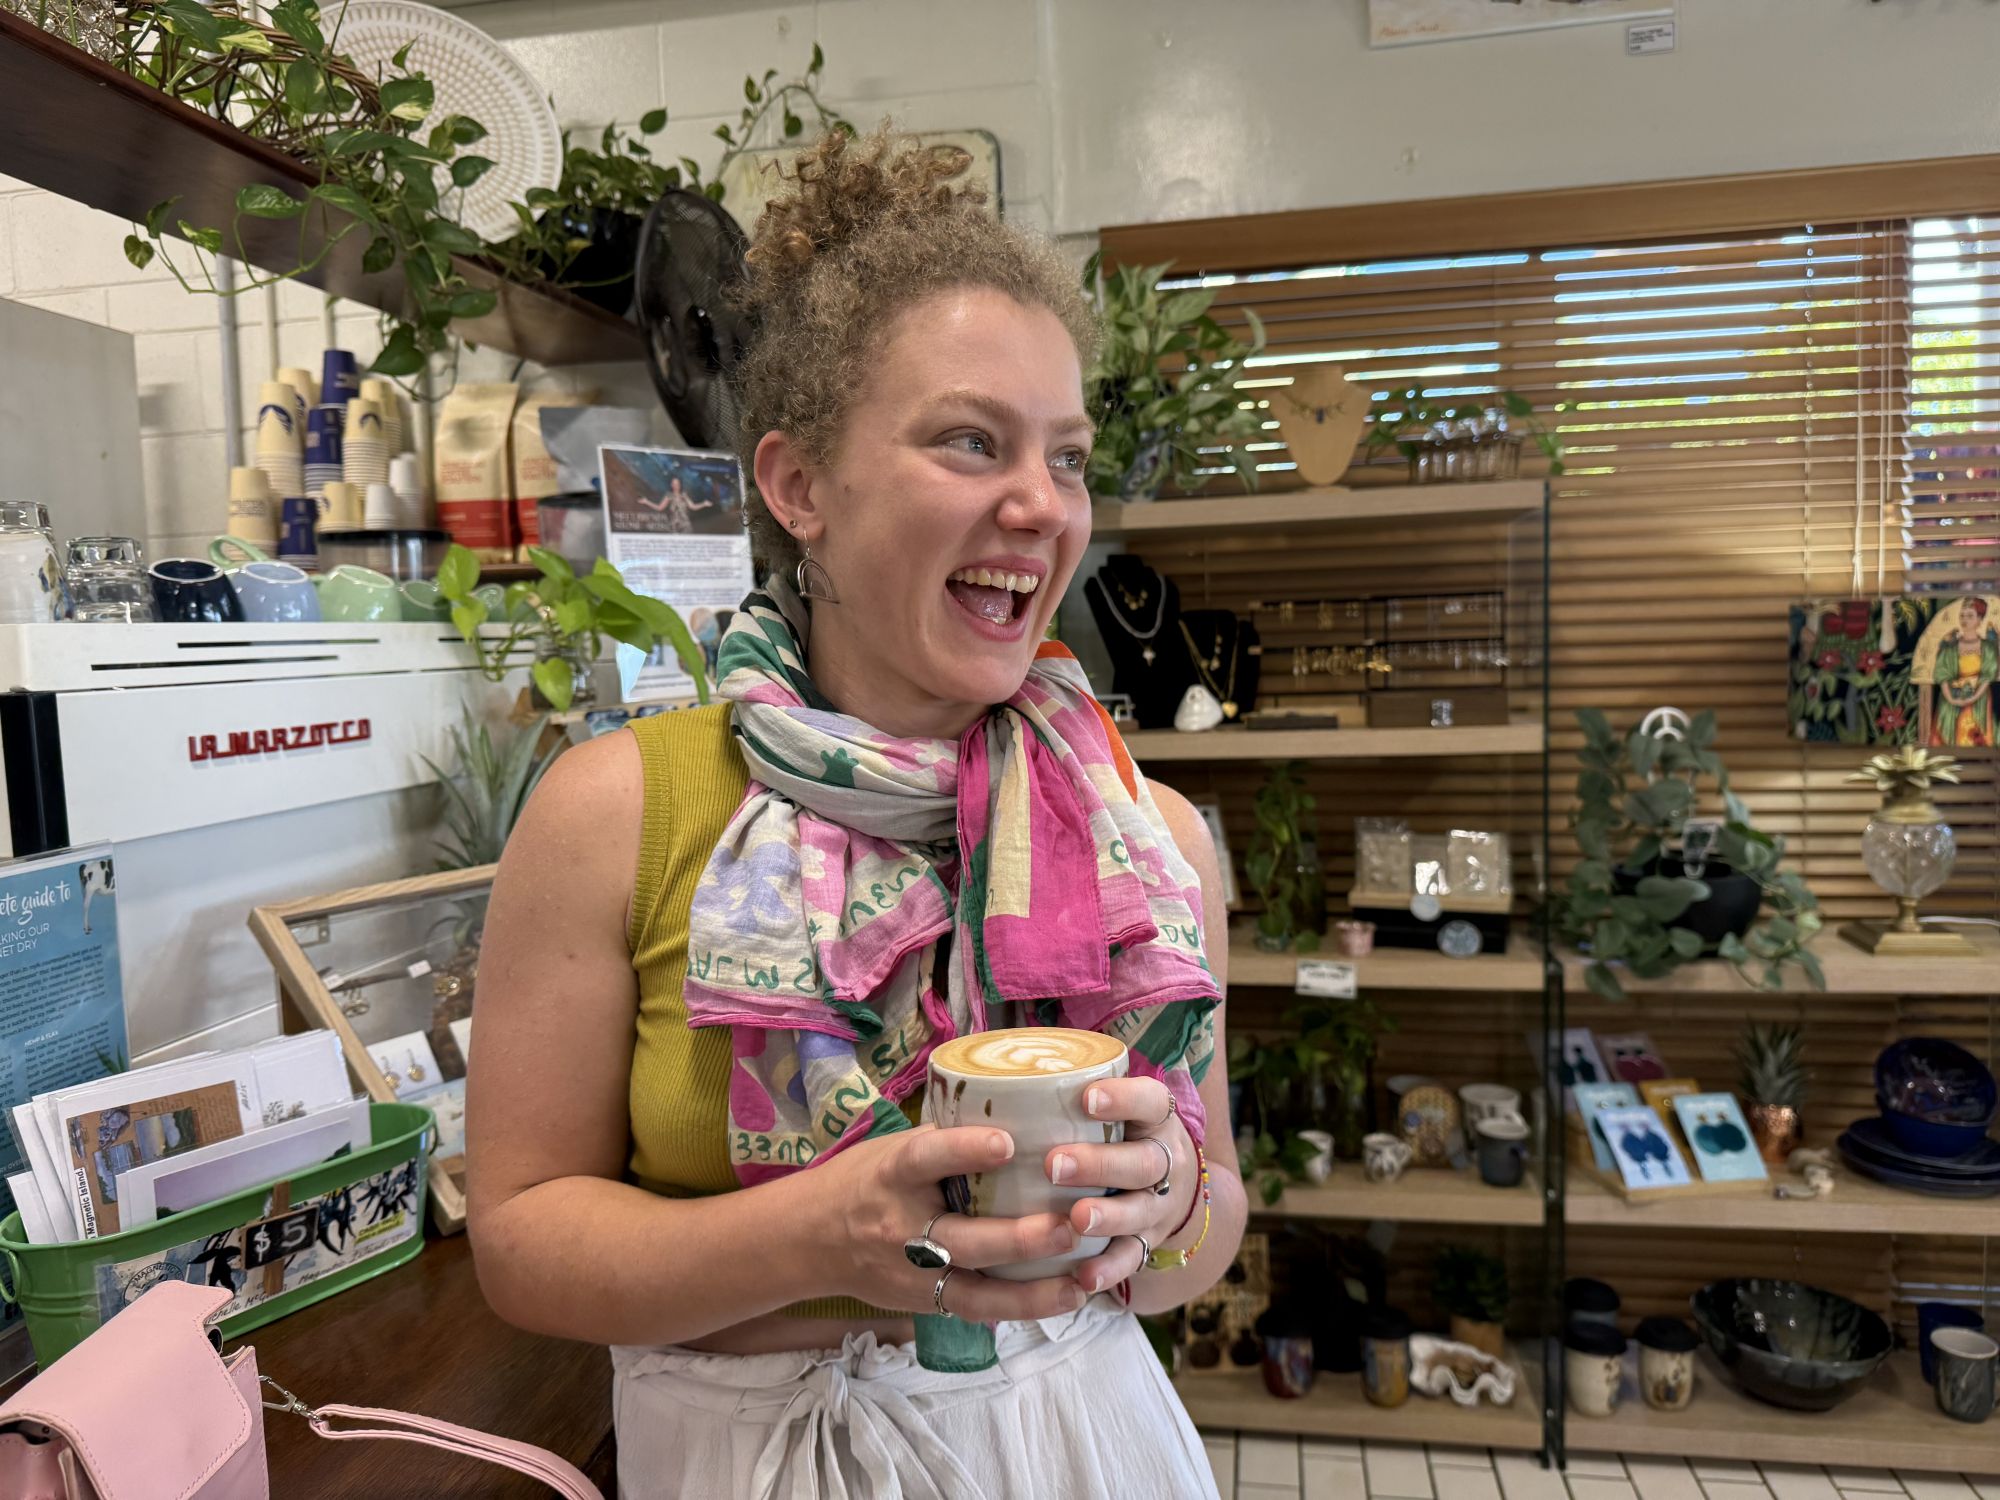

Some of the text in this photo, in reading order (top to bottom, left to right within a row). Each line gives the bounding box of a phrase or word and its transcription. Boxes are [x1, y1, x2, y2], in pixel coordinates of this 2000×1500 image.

[188, 718, 371, 762] LA MARZOCCO
[18, 885, 56, 926] guide
[55, 880, 71, 903] to
[0, 923, 50, 946] KING OUR
[17, 939, 37, 953] DRY
[76, 1168, 96, 1235] Magnetic Island.
